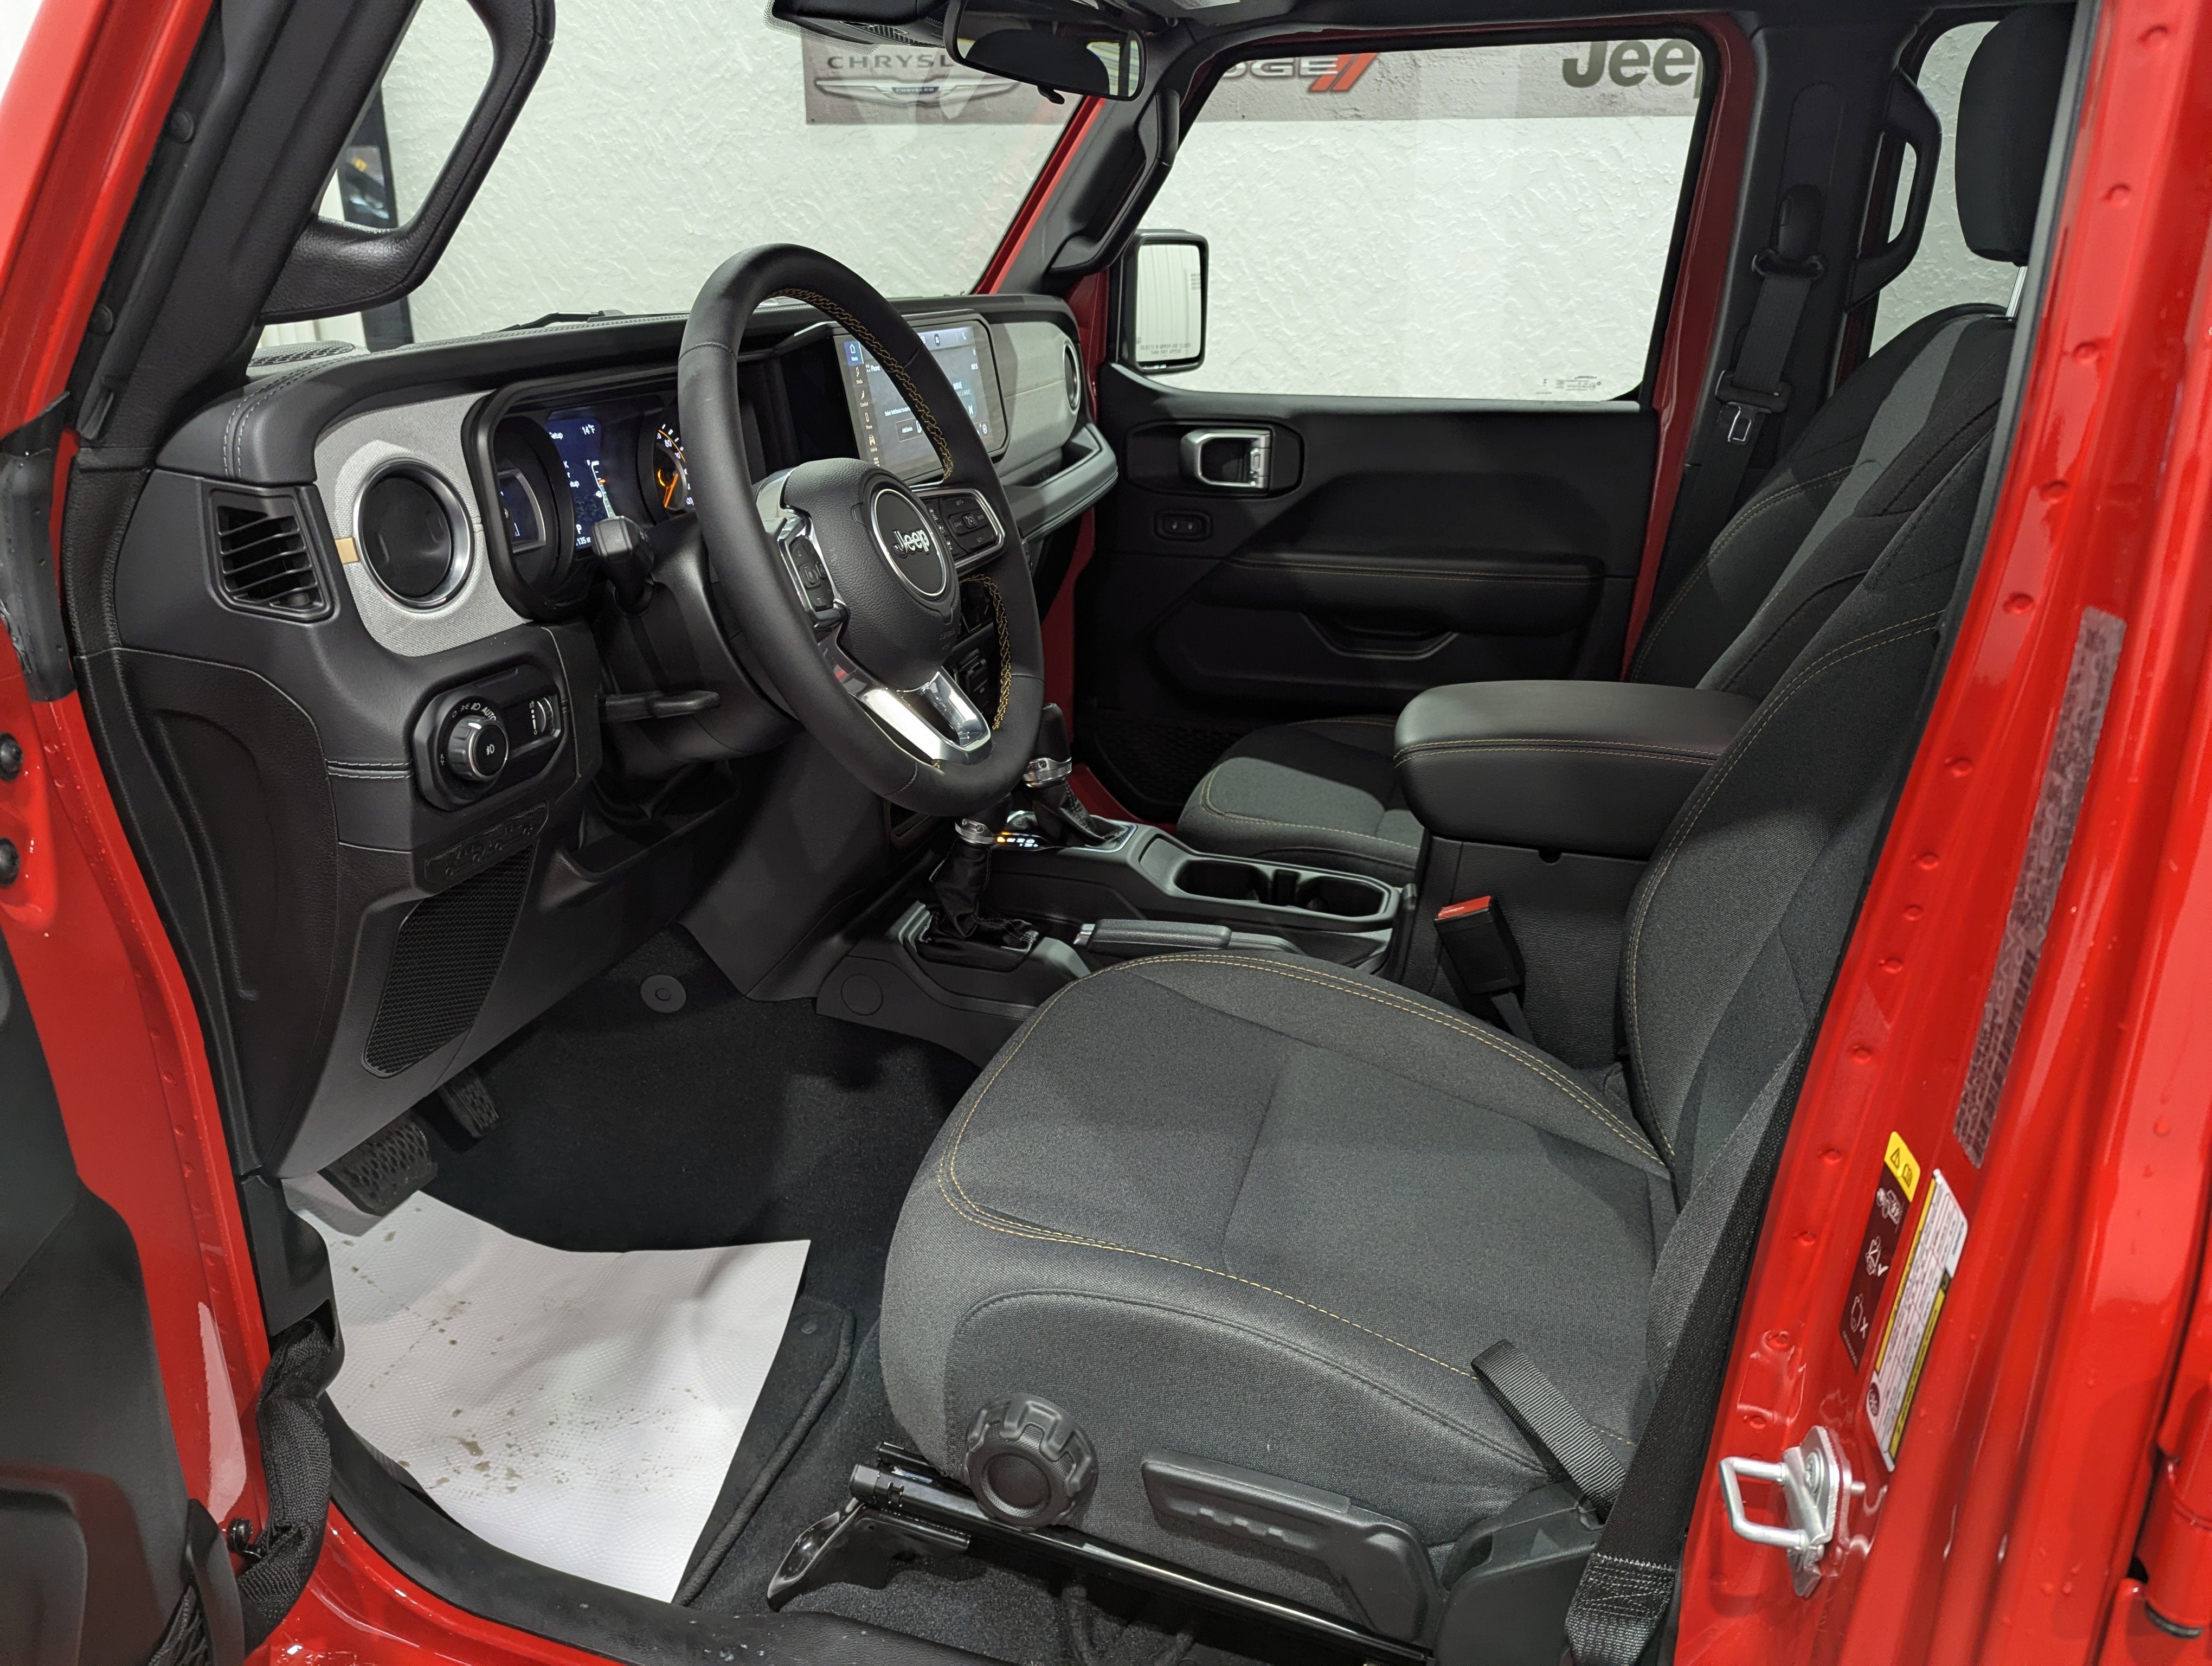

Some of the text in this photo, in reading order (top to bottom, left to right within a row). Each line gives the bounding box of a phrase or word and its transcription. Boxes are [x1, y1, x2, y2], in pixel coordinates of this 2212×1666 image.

[827, 54, 954, 69] CHRYSL
[892, 529, 930, 558] Jeep
[481, 707, 497, 721] AUTO
